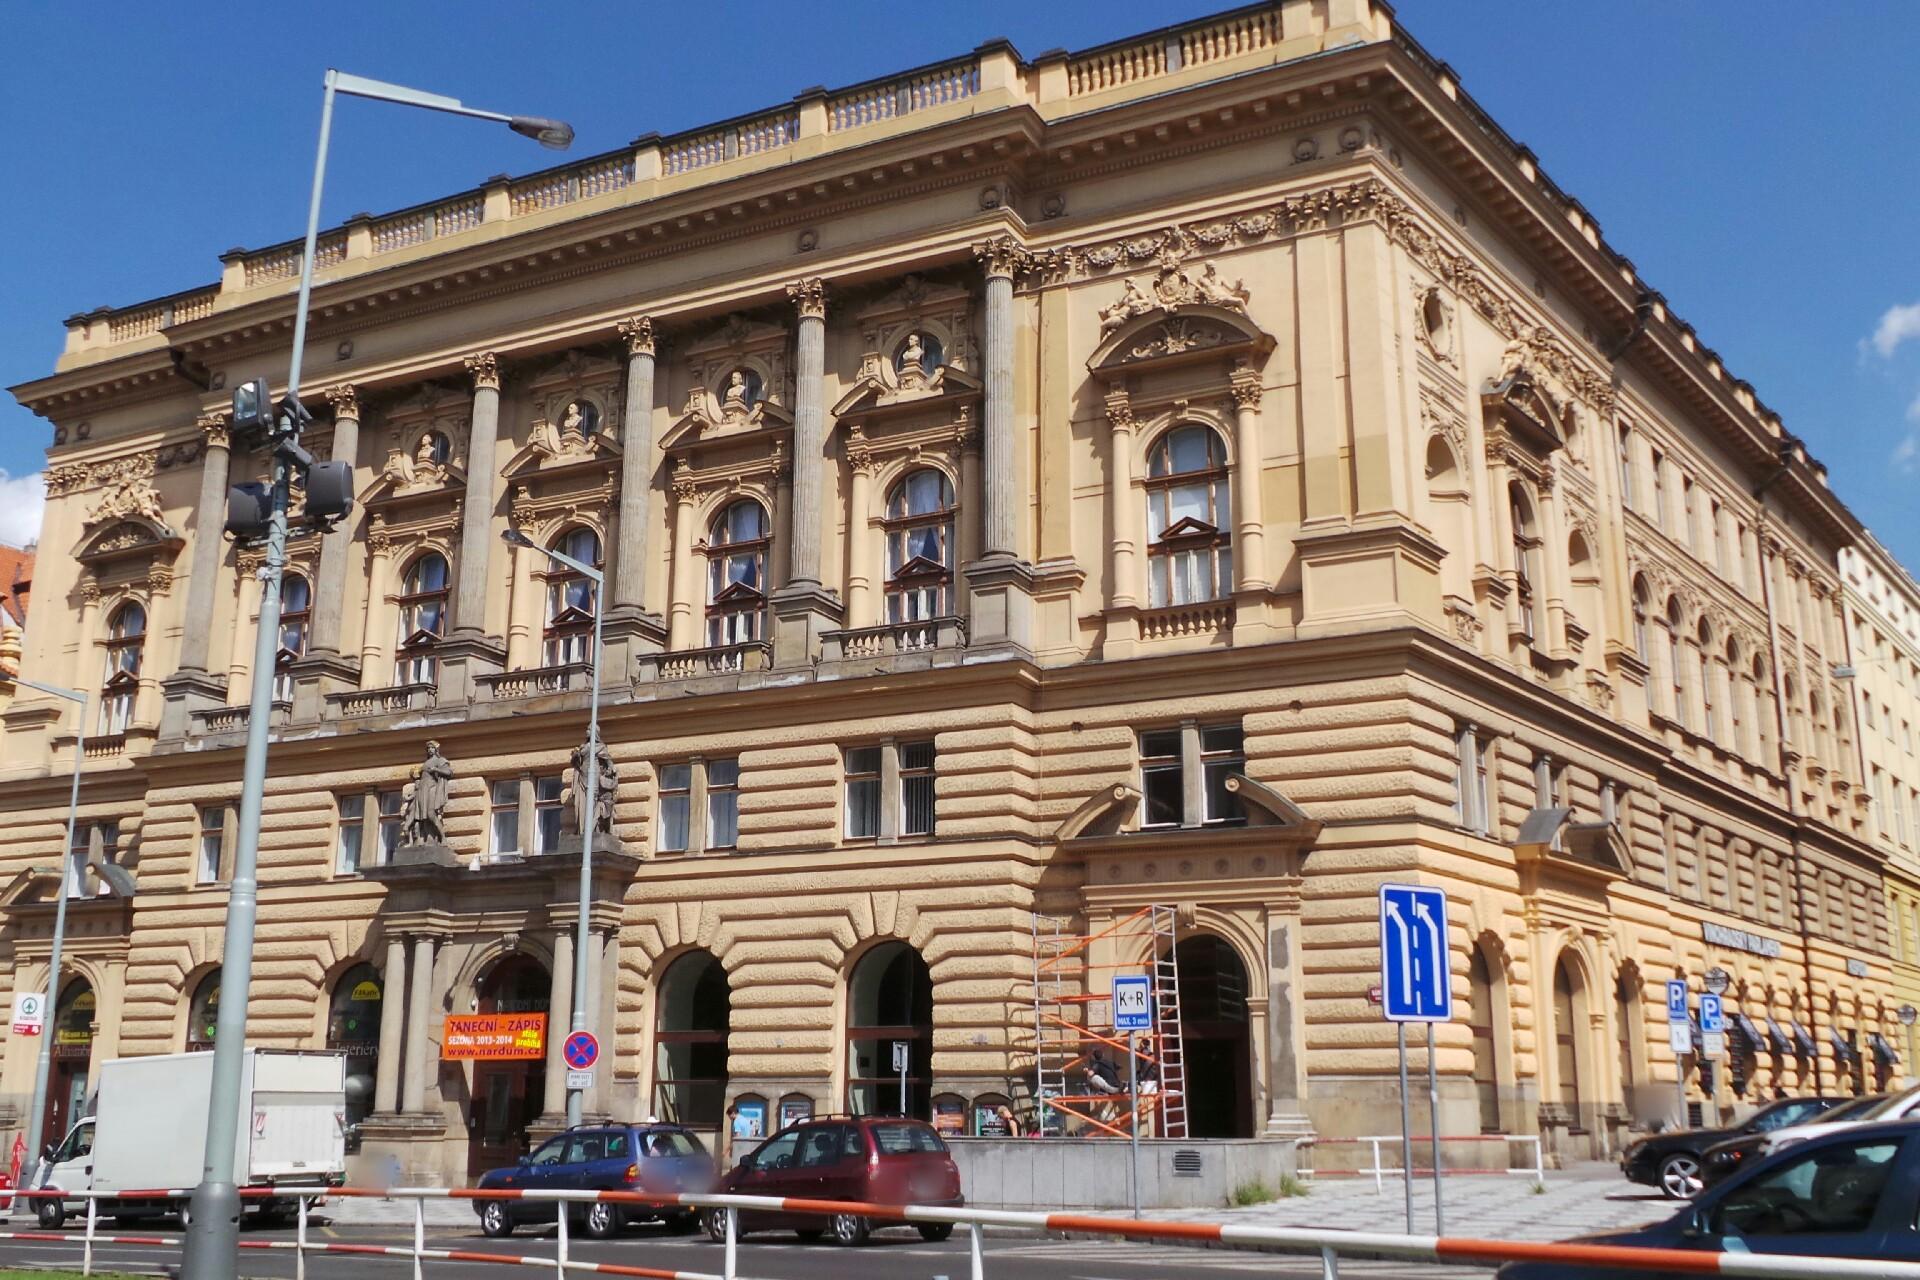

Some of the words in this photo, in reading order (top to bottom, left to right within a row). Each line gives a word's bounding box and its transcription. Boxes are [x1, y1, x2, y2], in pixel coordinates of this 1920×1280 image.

[1670, 984, 1683, 1010] P
[1703, 998, 1718, 1020] P
[450, 1018, 497, 1033] TANEČNÍ
[508, 1017, 541, 1032] ZÁPIS
[476, 1034, 513, 1045] 2013-2014
[447, 1046, 541, 1056] www.nardum.cz
